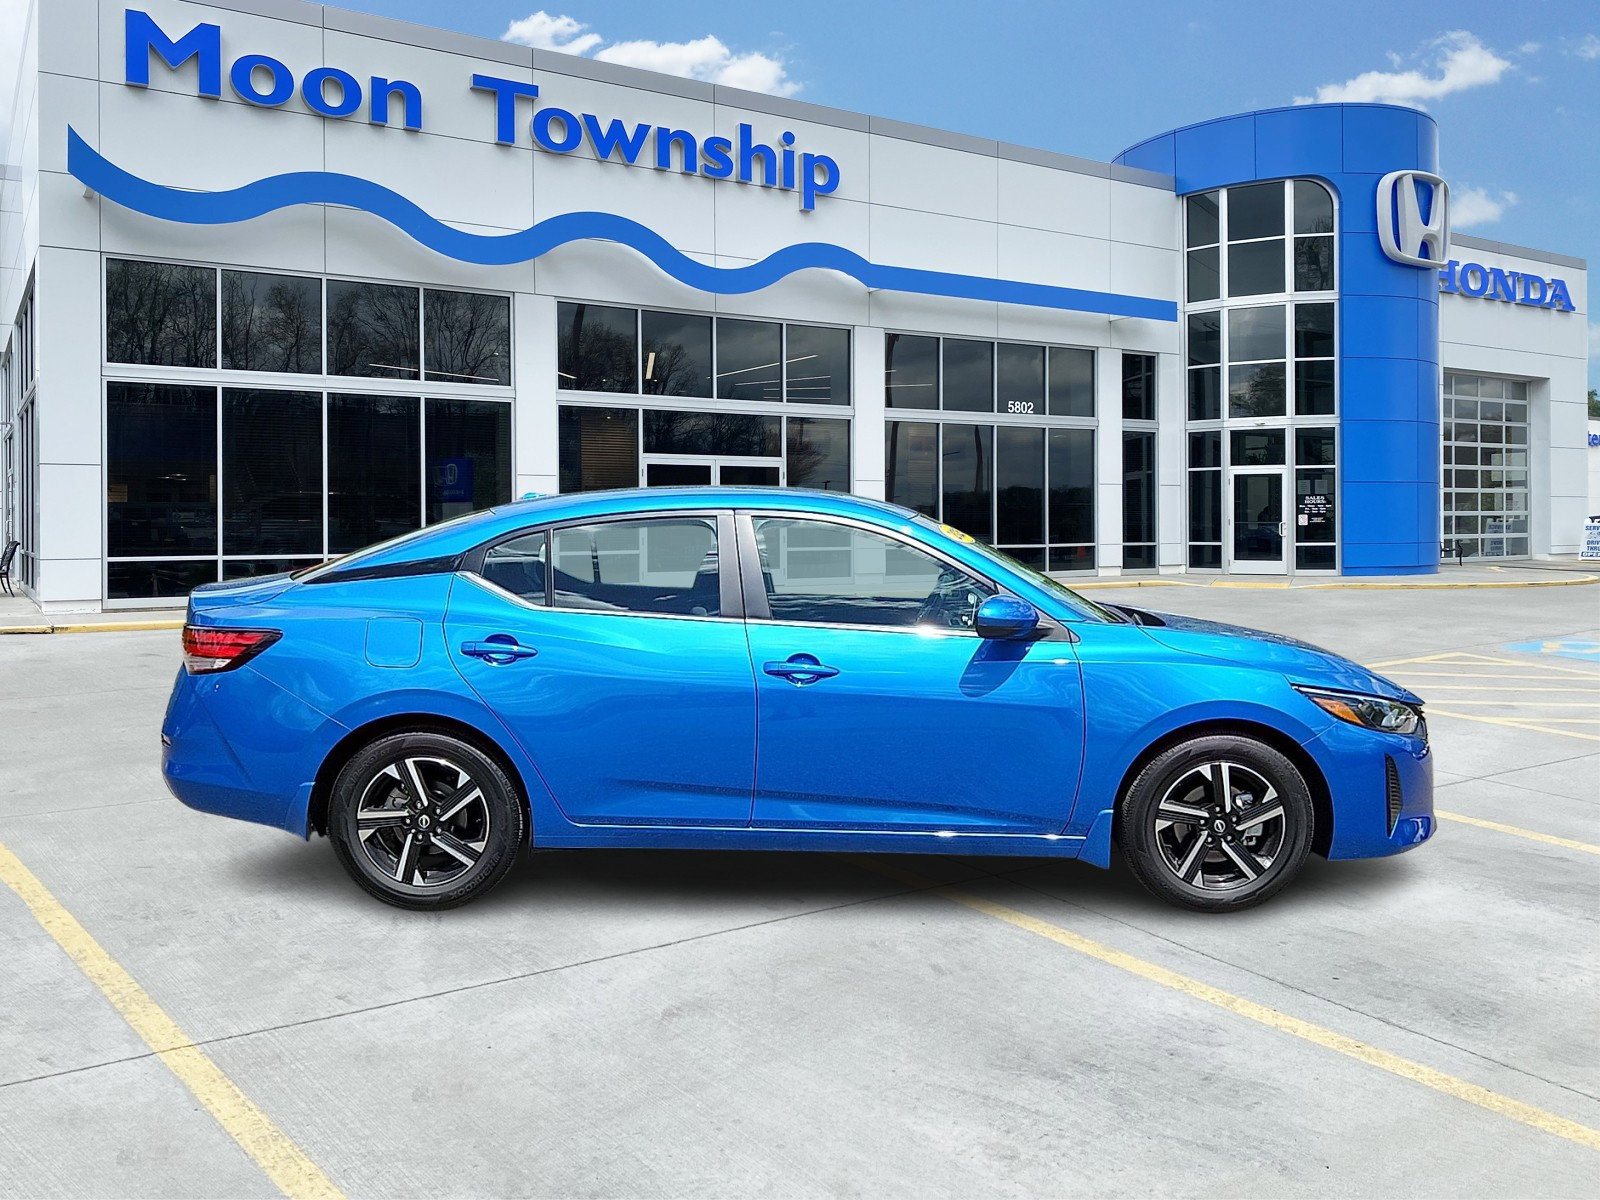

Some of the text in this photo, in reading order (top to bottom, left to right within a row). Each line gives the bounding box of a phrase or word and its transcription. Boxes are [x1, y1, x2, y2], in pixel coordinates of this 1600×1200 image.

[125, 8, 841, 212] Moon Township
[1007, 400, 1034, 414] 5802
